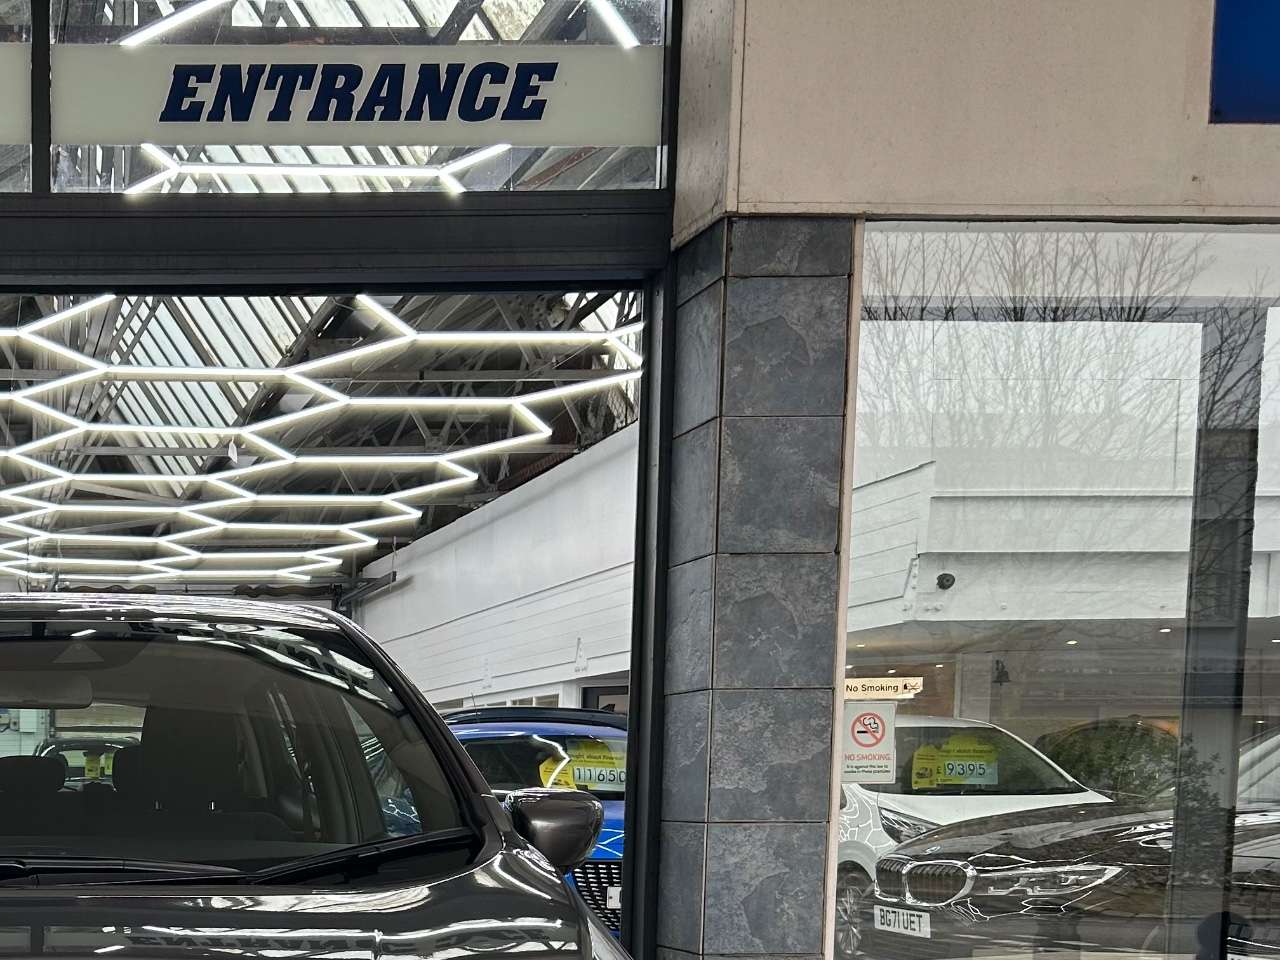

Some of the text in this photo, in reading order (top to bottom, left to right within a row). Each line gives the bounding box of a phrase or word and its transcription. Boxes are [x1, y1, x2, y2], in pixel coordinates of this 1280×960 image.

[158, 61, 559, 123] ENTRANCE
[845, 684, 899, 693] No Smoking
[844, 753, 855, 761] NO
